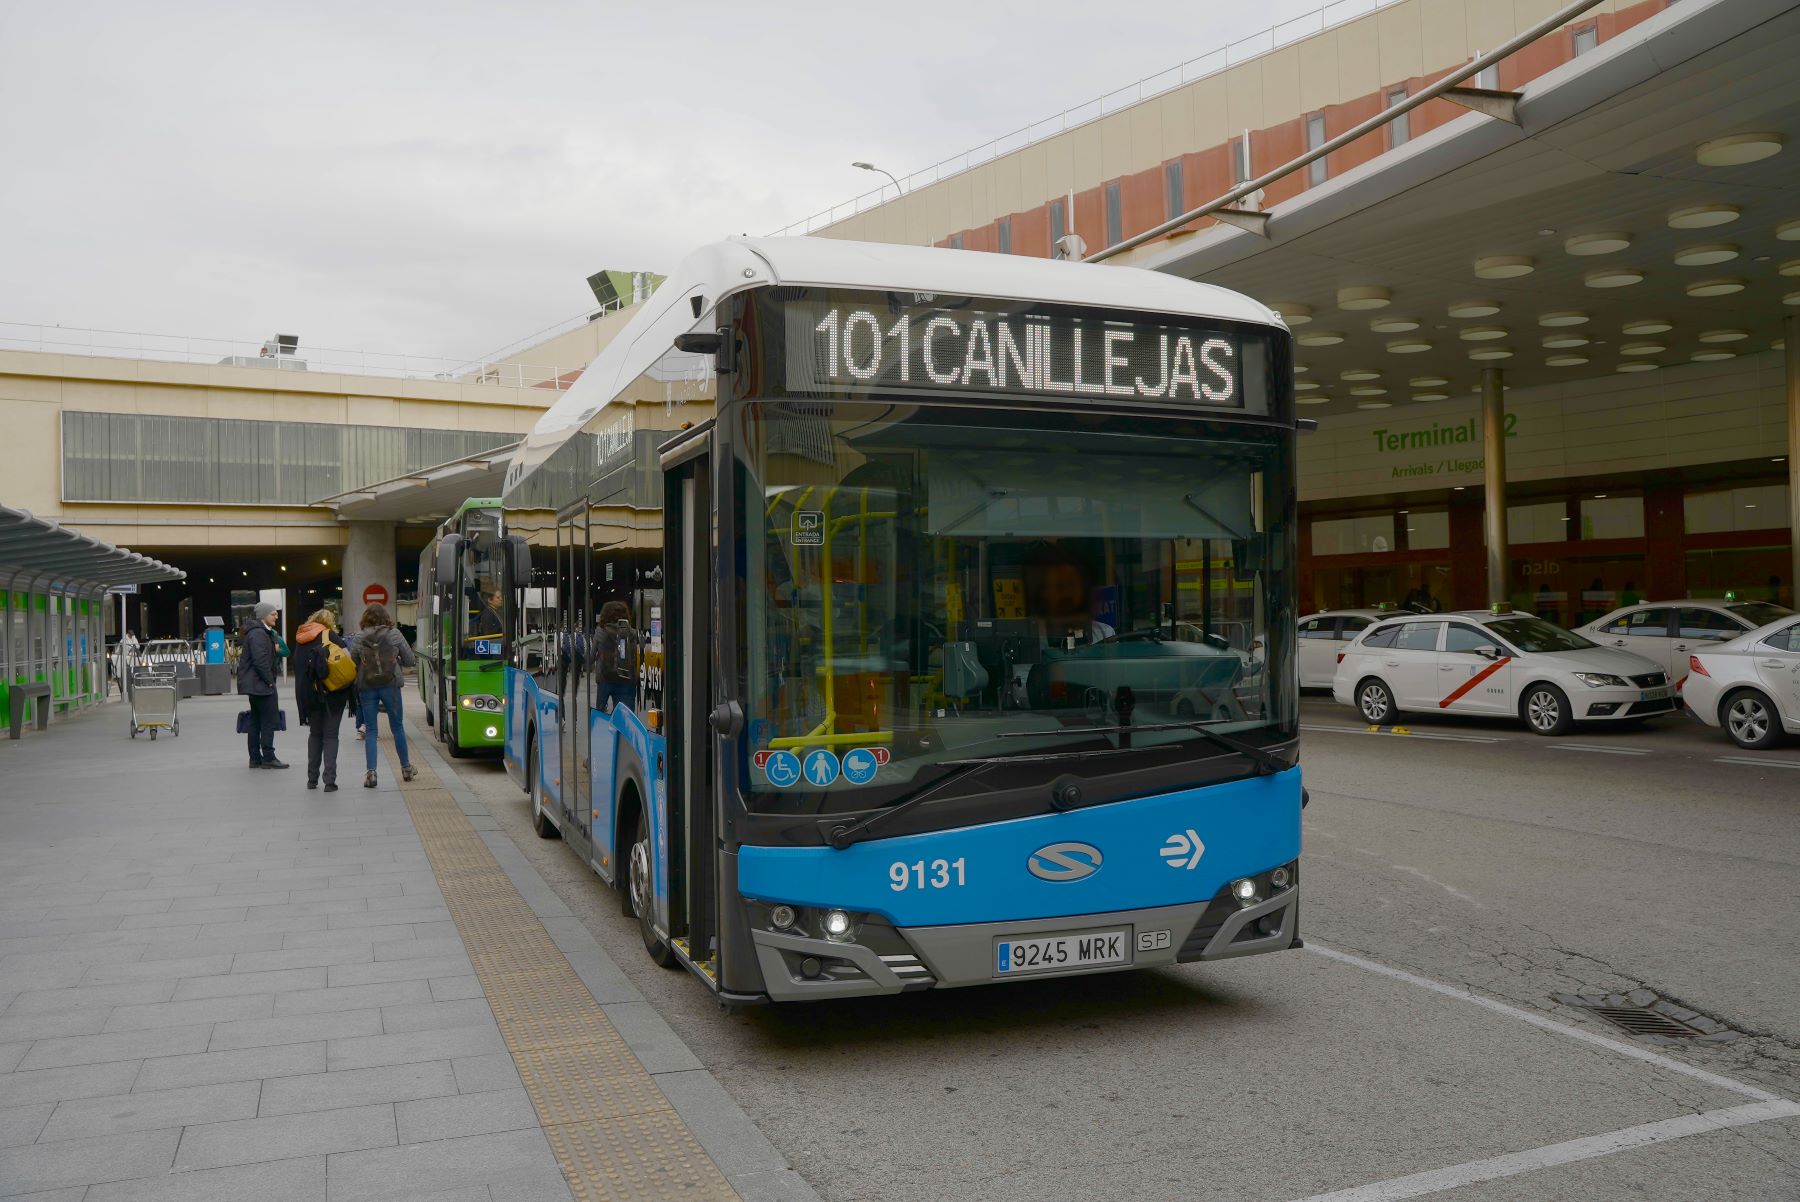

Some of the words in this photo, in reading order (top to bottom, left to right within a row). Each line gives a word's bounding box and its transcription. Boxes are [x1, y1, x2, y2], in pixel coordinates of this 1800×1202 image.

[815, 309, 909, 381] 101
[923, 317, 1233, 401] CANILLEJAS
[1373, 417, 1476, 452] Terminal
[1391, 462, 1434, 479] Arrivals
[889, 857, 965, 891] 9131
[1013, 941, 1068, 967] 9245
[1079, 936, 1121, 961] MRK
[1141, 931, 1168, 949] SP
